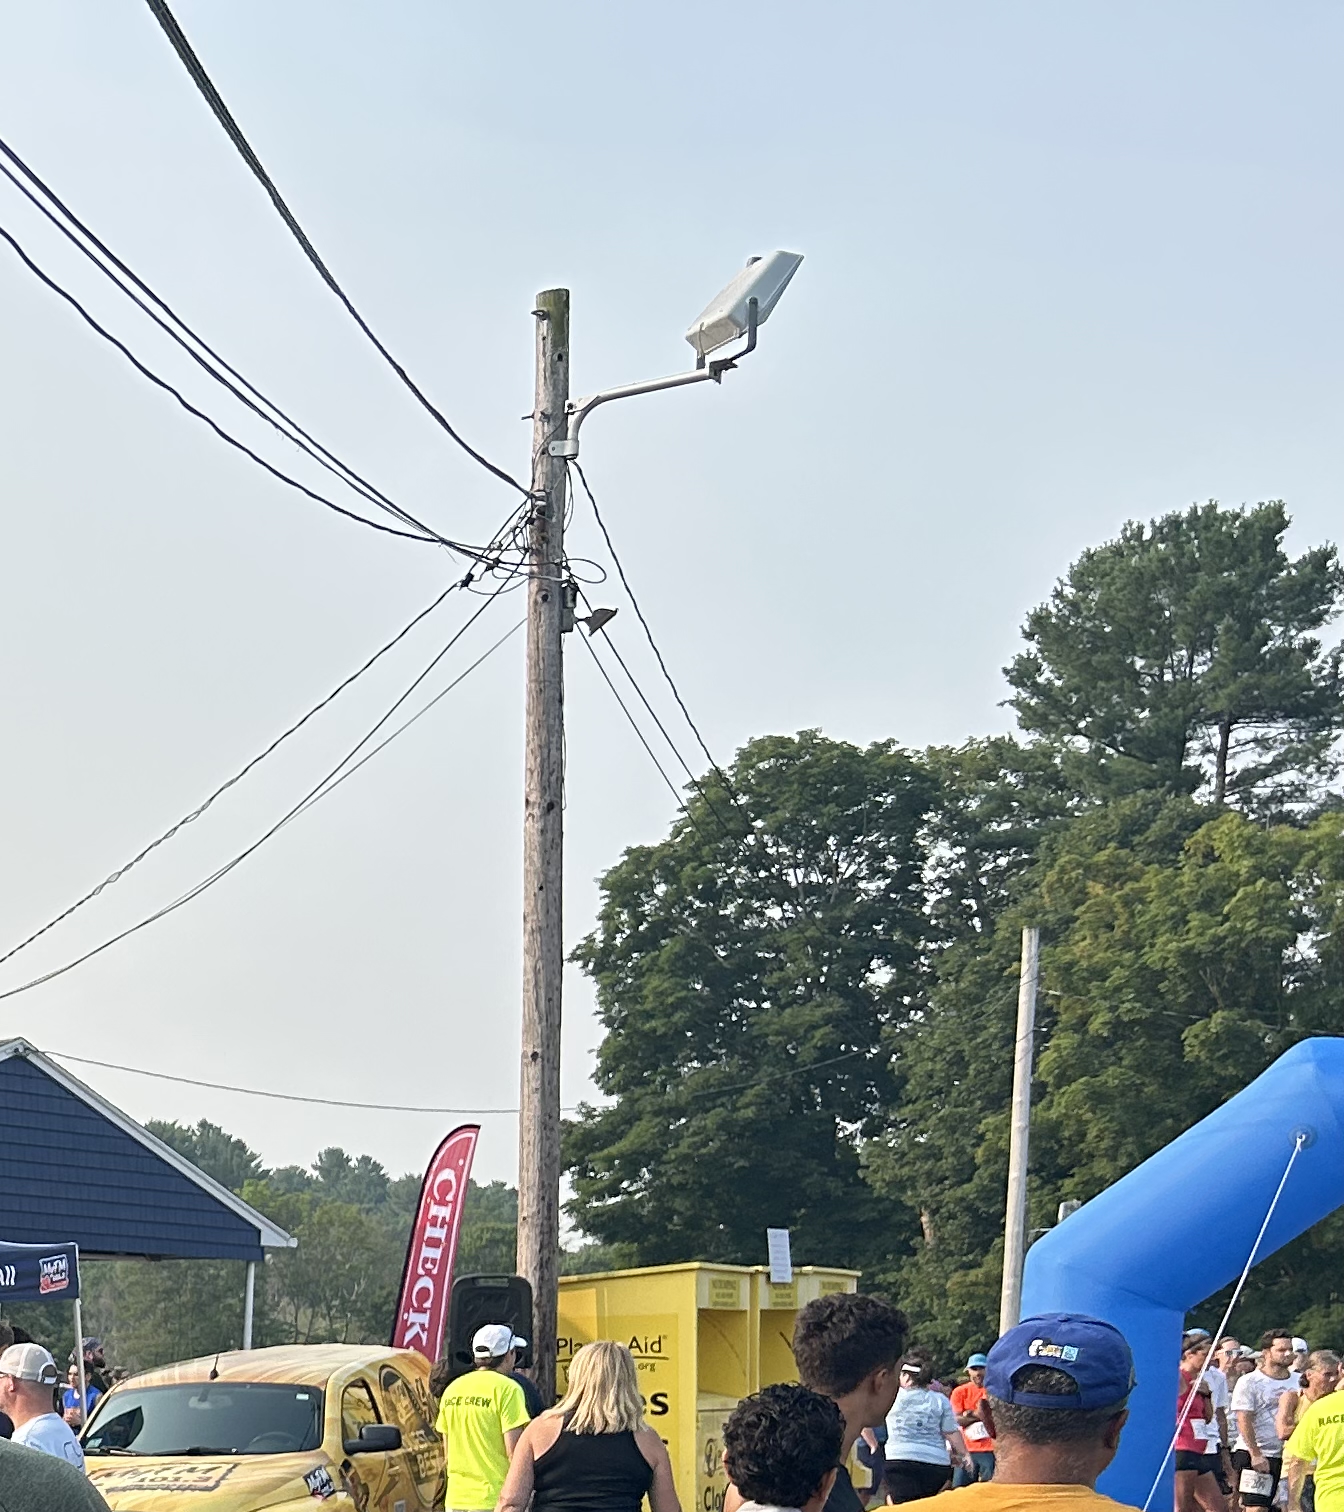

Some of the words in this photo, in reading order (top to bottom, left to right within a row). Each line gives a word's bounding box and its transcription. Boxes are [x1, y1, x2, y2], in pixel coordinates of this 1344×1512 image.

[403, 1168, 457, 1347] CHECK
[628, 1335, 662, 1354] Aid
[464, 1396, 492, 1409] CREW
